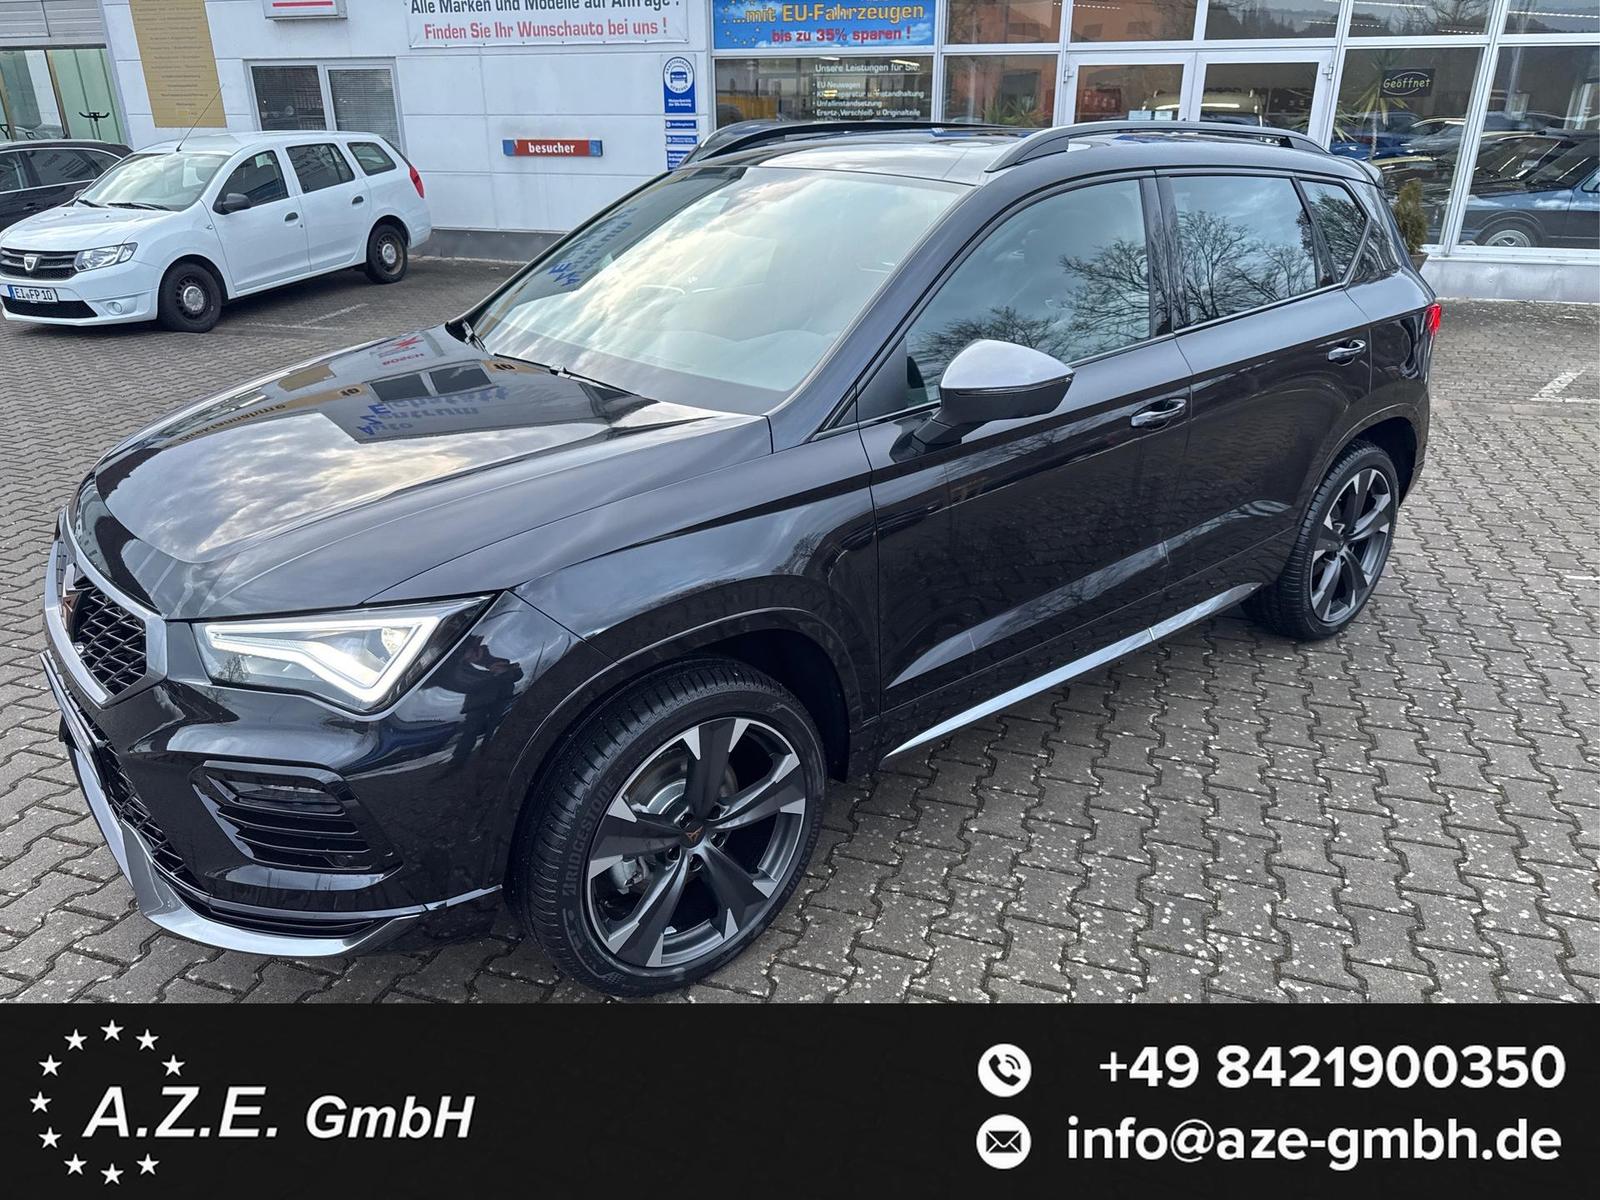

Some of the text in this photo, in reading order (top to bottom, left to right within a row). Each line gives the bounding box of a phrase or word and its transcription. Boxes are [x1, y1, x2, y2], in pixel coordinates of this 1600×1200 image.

[411, 0, 436, 14] Alle
[440, 0, 491, 13] Marken
[495, 0, 520, 12] und
[782, 3, 924, 24] EU-Fahrzeugen
[424, 23, 467, 40] Finden
[470, 22, 492, 39] Sie
[494, 21, 514, 38] Ihr
[517, 19, 604, 37] Wunschauto
[608, 18, 629, 36] bei
[633, 21, 659, 35] uns
[772, 29, 793, 42] bis
[796, 31, 811, 42] zu
[816, 27, 848, 42] 35%
[852, 29, 902, 44] sparen
[815, 64, 844, 72] Unsere
[845, 64, 889, 74] Leistungen
[890, 63, 904, 71] für
[1383, 77, 1431, 89] Geöffnet
[528, 142, 576, 154] besucher
